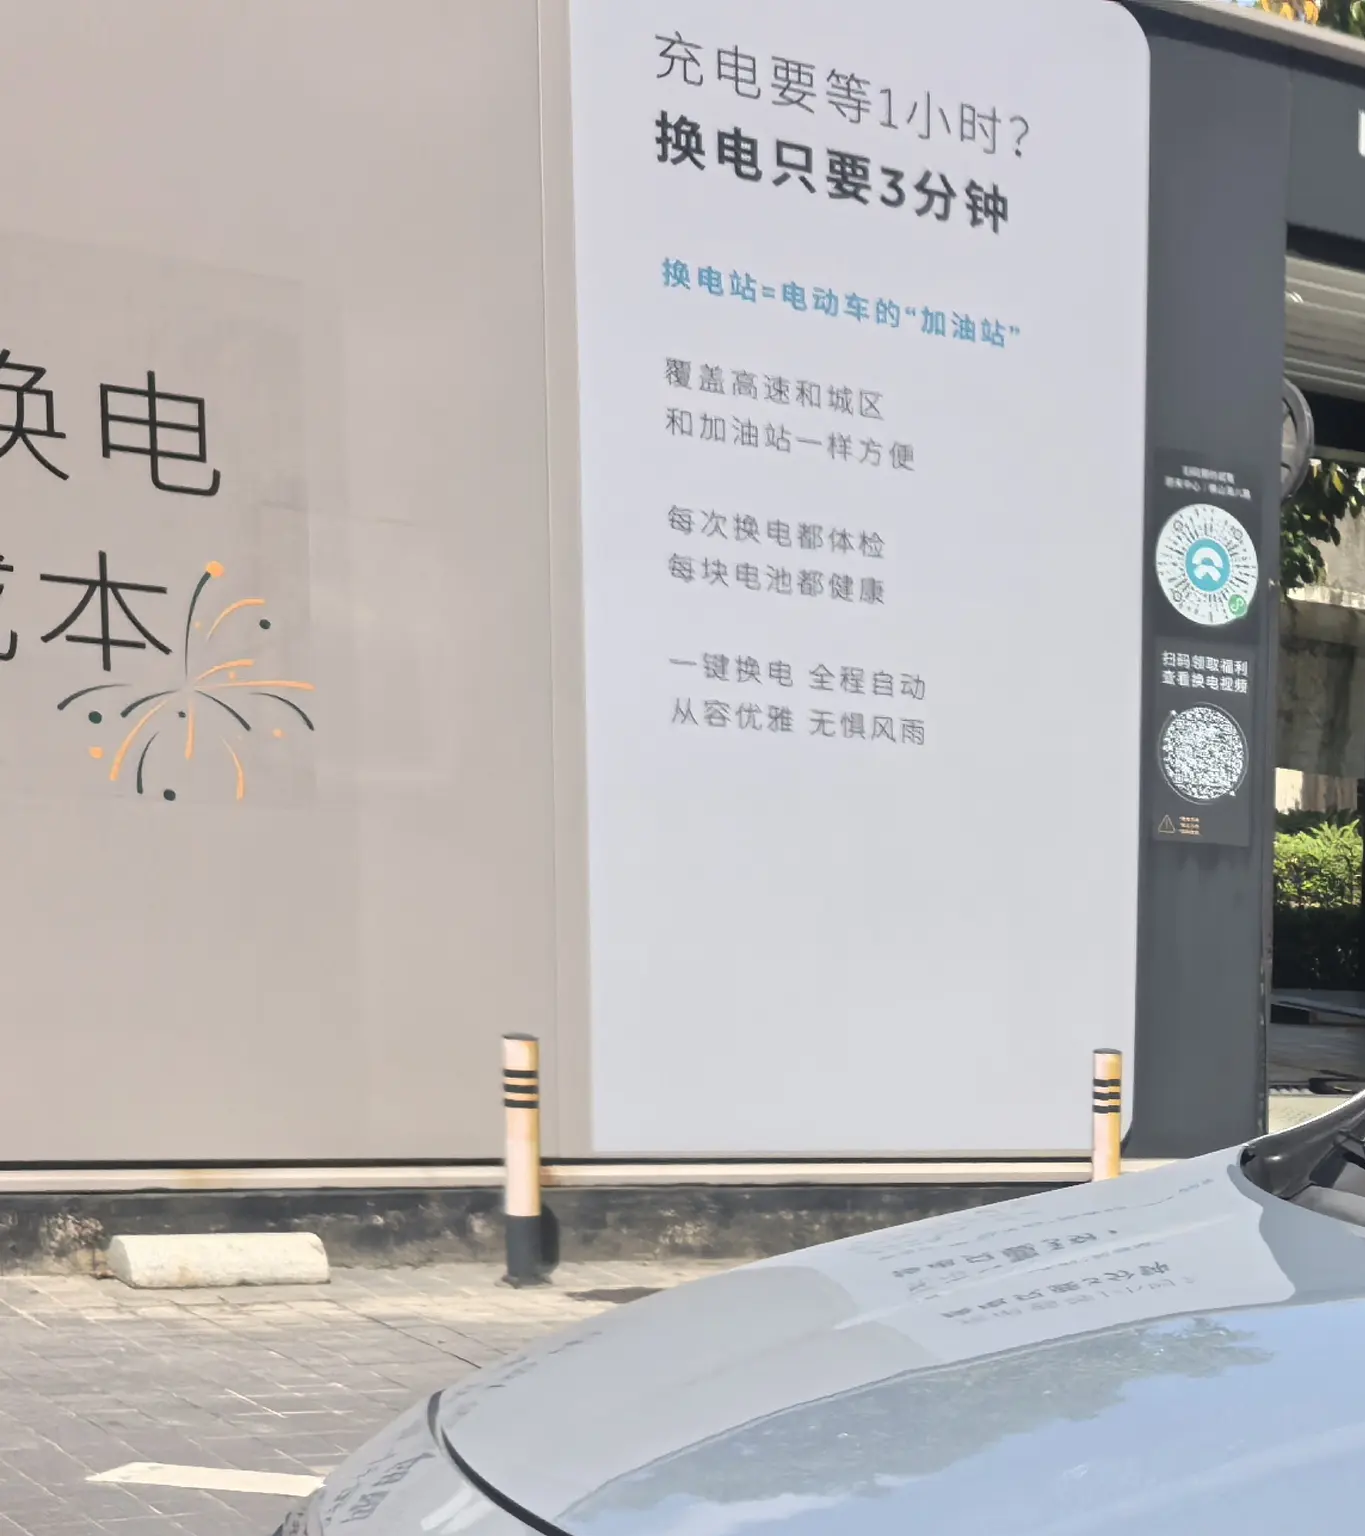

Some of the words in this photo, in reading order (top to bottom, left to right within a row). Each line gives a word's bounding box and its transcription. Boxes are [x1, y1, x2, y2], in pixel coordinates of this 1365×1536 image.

[655, 31, 1030, 158] 充电要等1小时？
[655, 110, 1009, 235] 换电只要3分钟
[661, 256, 1021, 349] 换电站=电动车的“加油站”
[664, 356, 884, 421] 覆盖高速和城区
[665, 407, 915, 472] 和加油站一样方便
[667, 504, 886, 559] 每次换电都体检
[0, 550, 172, 672] 本
[667, 552, 885, 605] 每块电池都健康
[668, 652, 794, 688] 一键换电
[808, 663, 926, 701] 全程自动
[671, 697, 794, 733] 从容优雅
[809, 708, 925, 746] 无惧风雨
